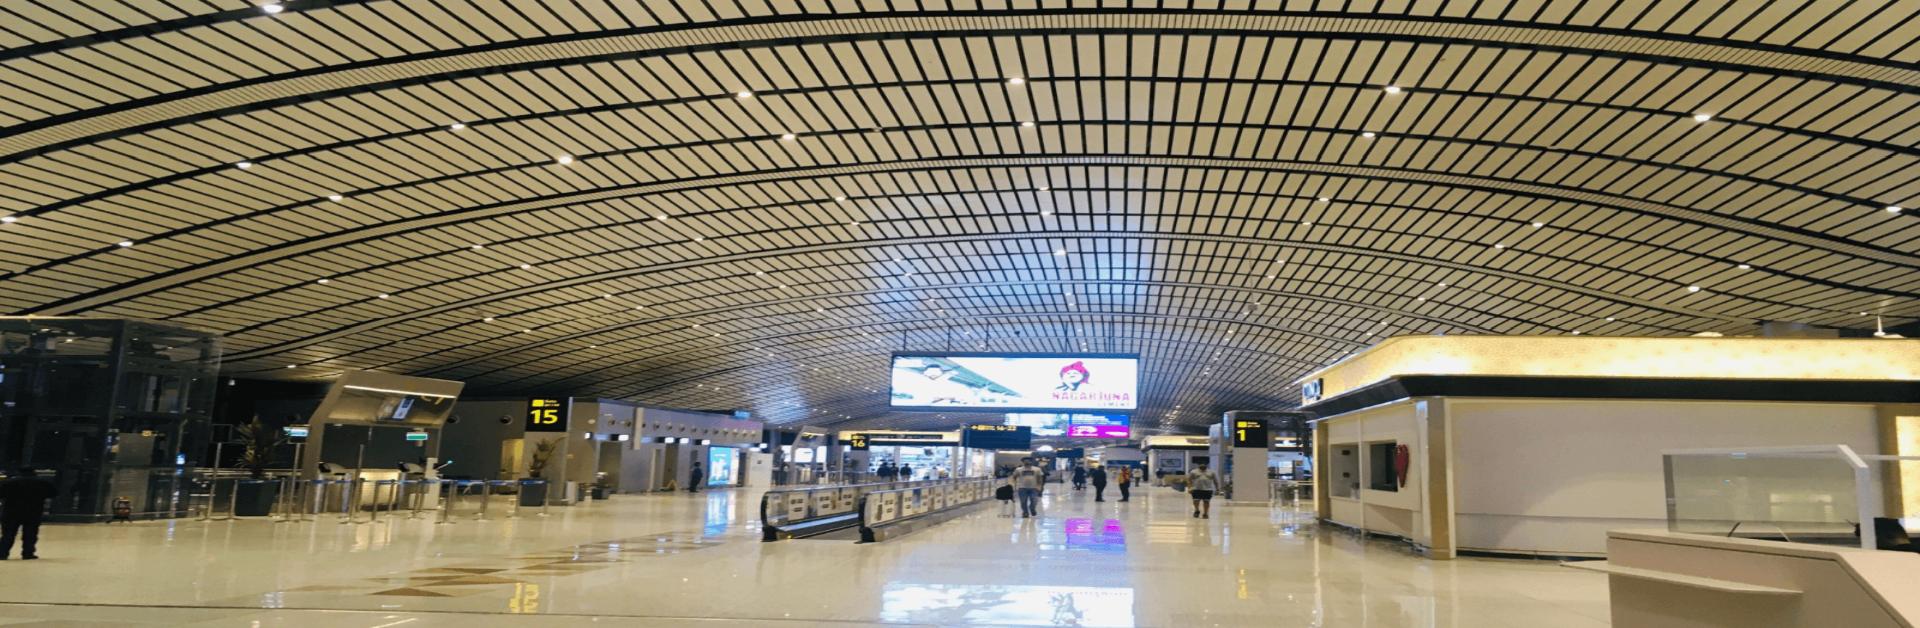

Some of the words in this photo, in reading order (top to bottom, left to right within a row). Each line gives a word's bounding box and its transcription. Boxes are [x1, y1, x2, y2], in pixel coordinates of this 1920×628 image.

[530, 409, 559, 424] 15
[1236, 429, 1246, 442] 1
[852, 439, 865, 448] 16
